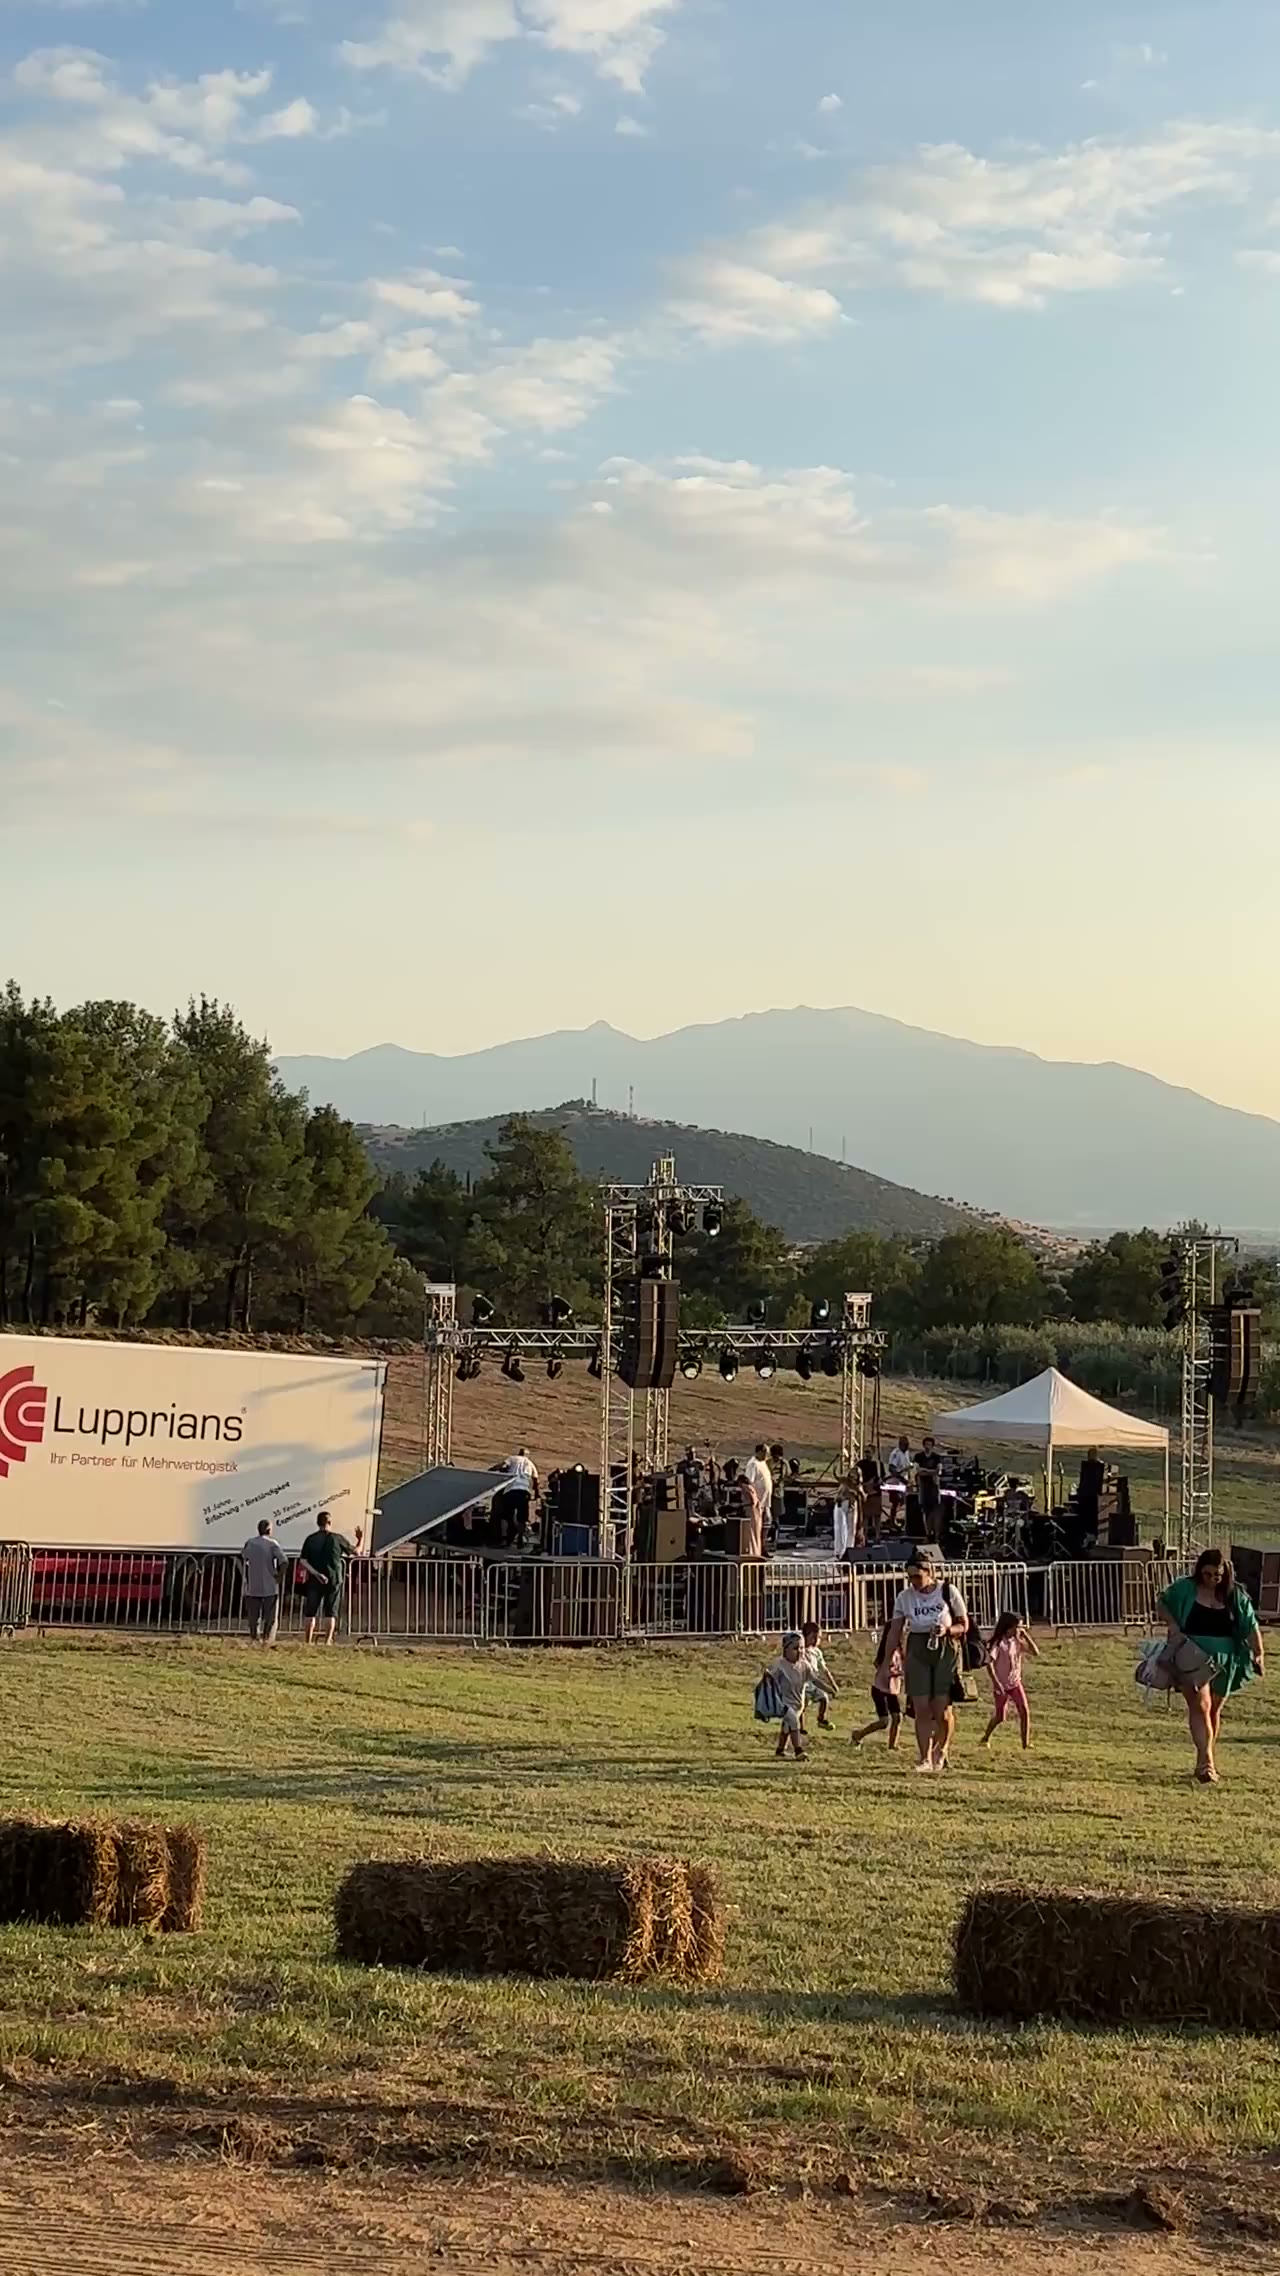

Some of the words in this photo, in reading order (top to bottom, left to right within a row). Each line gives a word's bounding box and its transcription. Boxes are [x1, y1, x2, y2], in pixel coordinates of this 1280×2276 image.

[53, 1396, 243, 1446] Lupprians
[50, 1452, 66, 1465] Ihr
[71, 1453, 117, 1467] Partner
[121, 1455, 138, 1468] für
[142, 1456, 238, 1475] Mehrwertlogistik
[914, 1603, 943, 1617] BOSS
